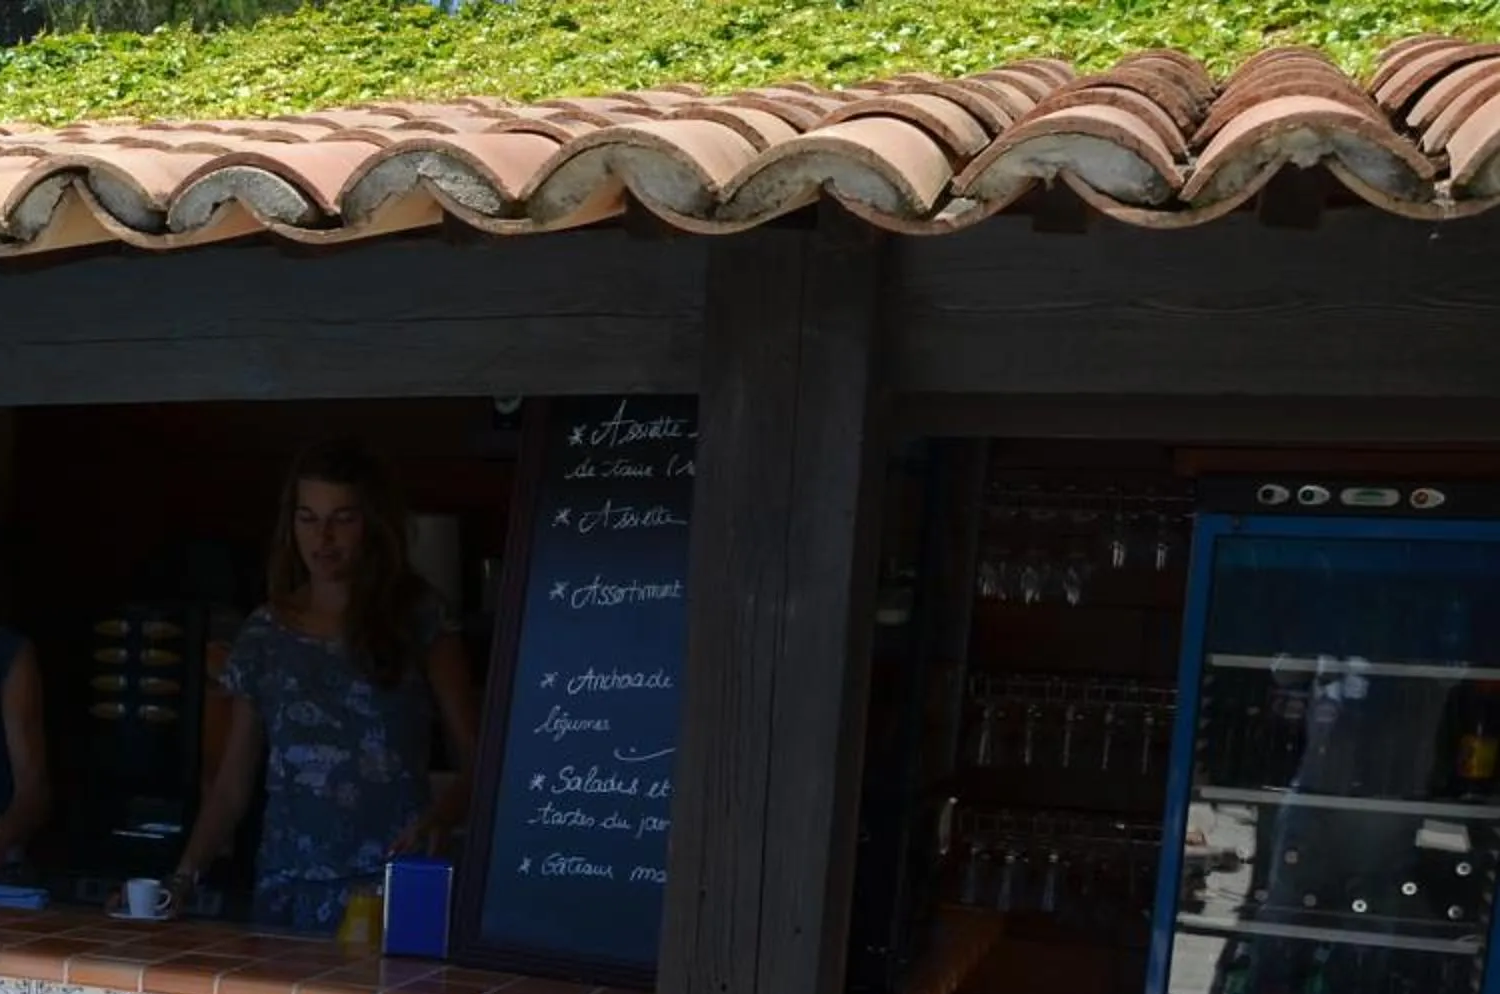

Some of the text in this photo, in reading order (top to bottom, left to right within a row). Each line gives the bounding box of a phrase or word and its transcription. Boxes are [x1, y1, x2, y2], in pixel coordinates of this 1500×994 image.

[550, 764, 673, 799] Salades et
[598, 810, 632, 830] du
